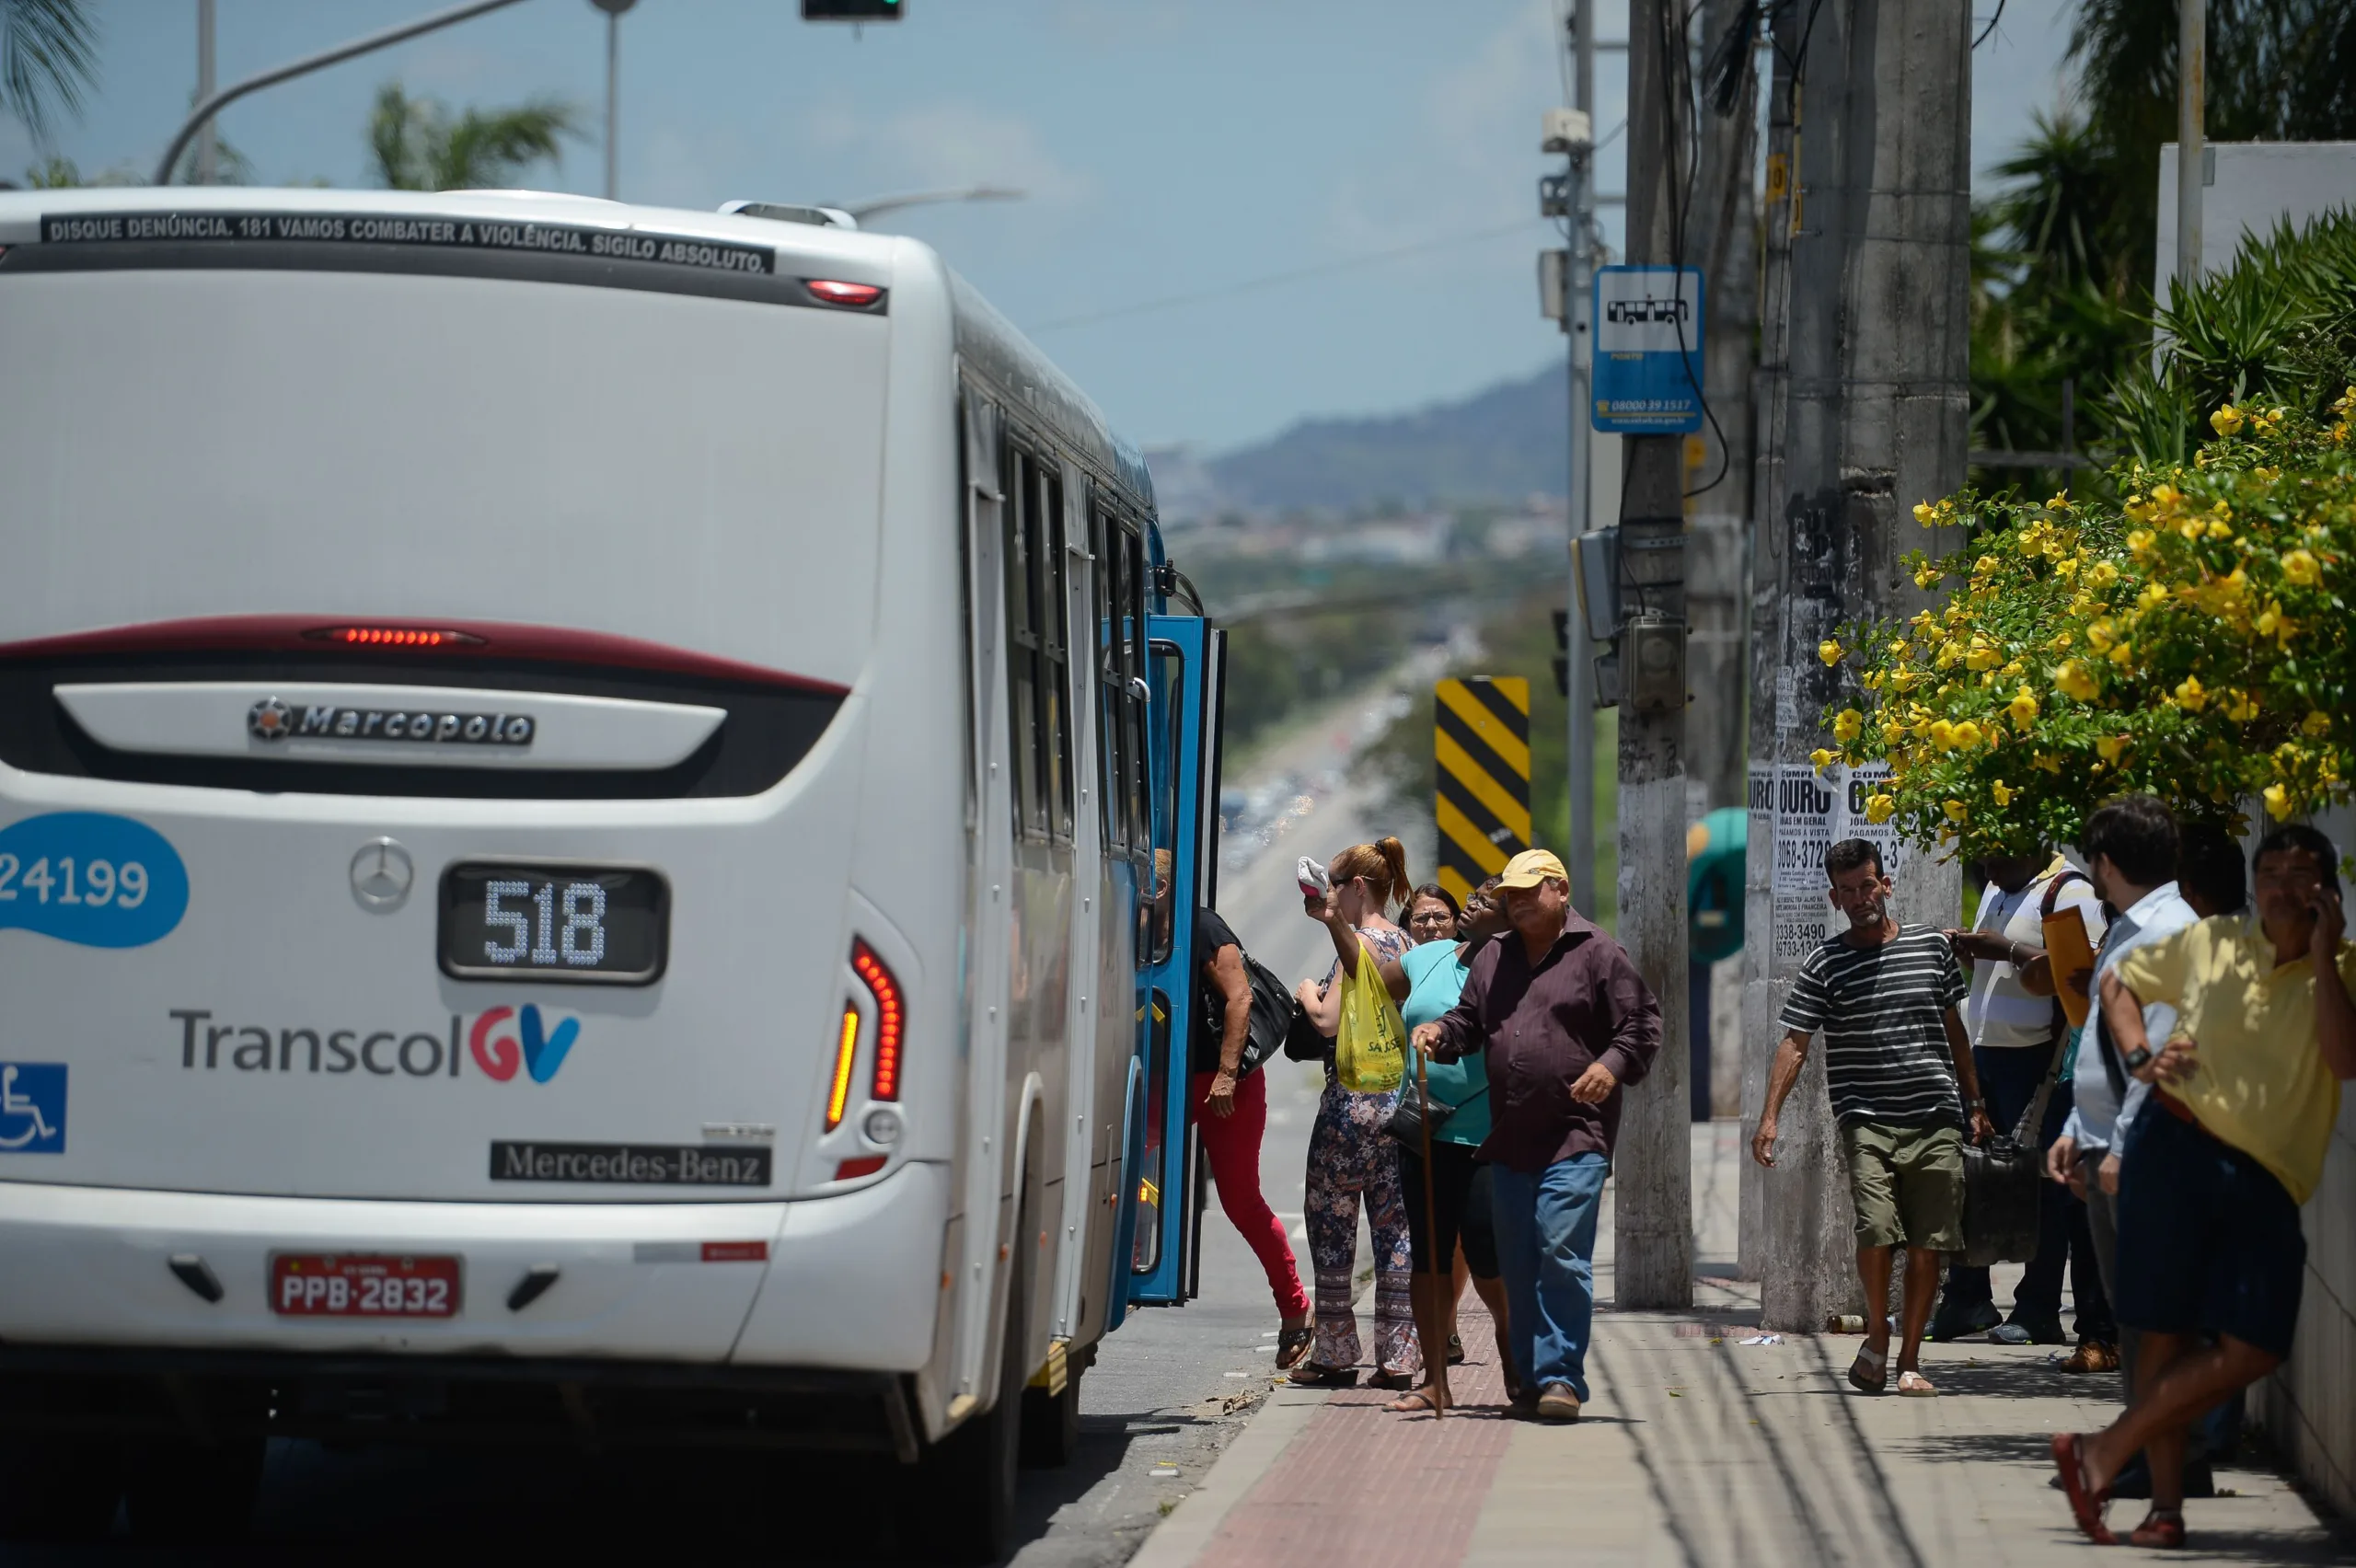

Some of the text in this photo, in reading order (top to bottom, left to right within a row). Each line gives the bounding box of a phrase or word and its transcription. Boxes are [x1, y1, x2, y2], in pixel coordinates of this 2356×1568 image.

[51, 219, 122, 241] DISQUE
[128, 213, 234, 237] DENÚNCIA.
[239, 217, 271, 236] 181
[278, 218, 345, 238] VAMOS
[351, 220, 455, 242] COMBATER
[460, 224, 475, 242] A
[479, 224, 586, 252] VIOLÊNCIA.
[592, 234, 656, 259] SIGILO
[299, 705, 531, 742] Marcopolo
[1748, 779, 1774, 810] URO
[1780, 779, 1831, 814] OURO
[1794, 816, 1802, 825] EM
[1804, 817, 1827, 826] GERAL
[1849, 815, 1874, 826] JÓIA
[0, 852, 149, 910] 24199
[484, 881, 606, 965] 518
[503, 1145, 761, 1182] Mercedes-Benz
